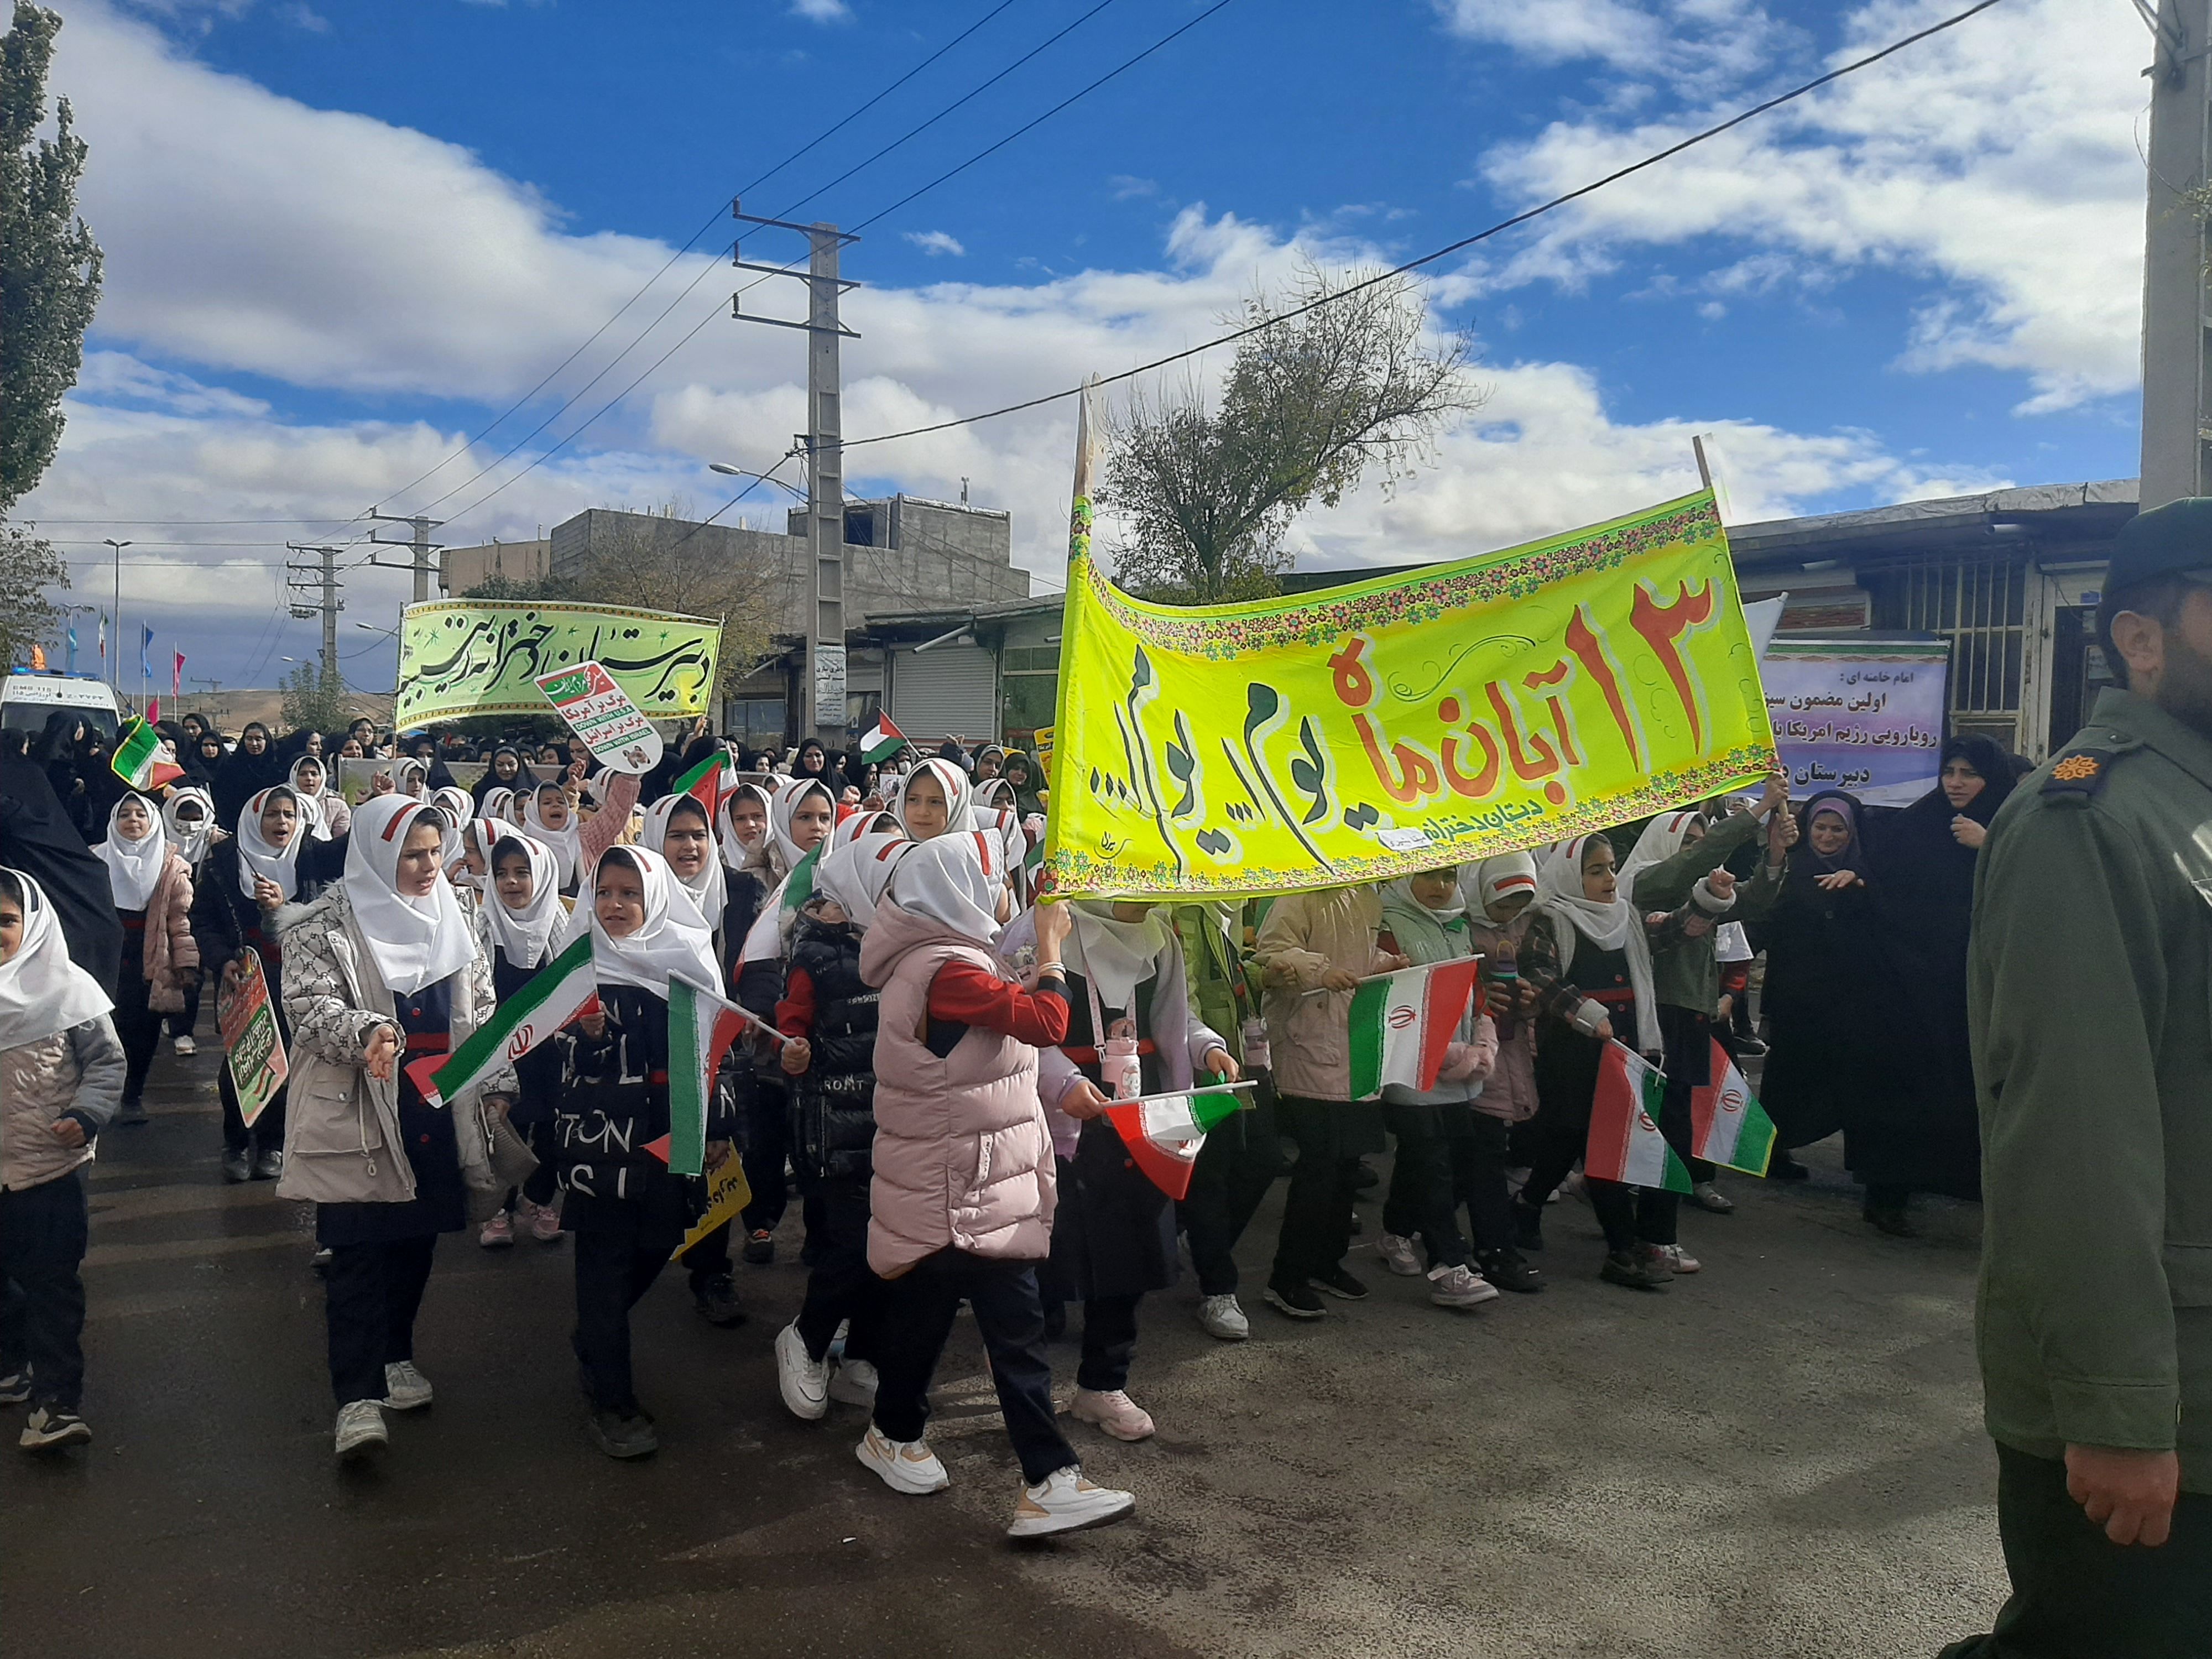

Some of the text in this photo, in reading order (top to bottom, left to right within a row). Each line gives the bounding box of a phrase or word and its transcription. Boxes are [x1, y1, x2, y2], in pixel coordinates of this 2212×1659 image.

[1564, 577, 1712, 773] ۱۳
[1847, 671, 1860, 684] ای
[1863, 671, 1890, 682] خامنه
[1893, 672, 1914, 685] امام
[561, 700, 594, 720] آمریکا
[608, 694, 627, 707] مرگ
[1790, 692, 1843, 710] مضمون
[1848, 692, 1886, 712] اولین
[576, 719, 597, 731] DOWN
[596, 712, 615, 725] WITH
[625, 716, 644, 728] مرگ
[1328, 637, 1439, 804] ماه
[593, 729, 652, 753] DOWN WITH ISRAEL
[1438, 660, 1580, 806] آبان
[1787, 721, 1832, 742] امریکا
[1835, 724, 1867, 744] رژیم
[1872, 726, 1937, 747] رویارویی
[1794, 762, 1870, 787] دبیرستان
[1422, 799, 1543, 842] دبستان دخترانه
